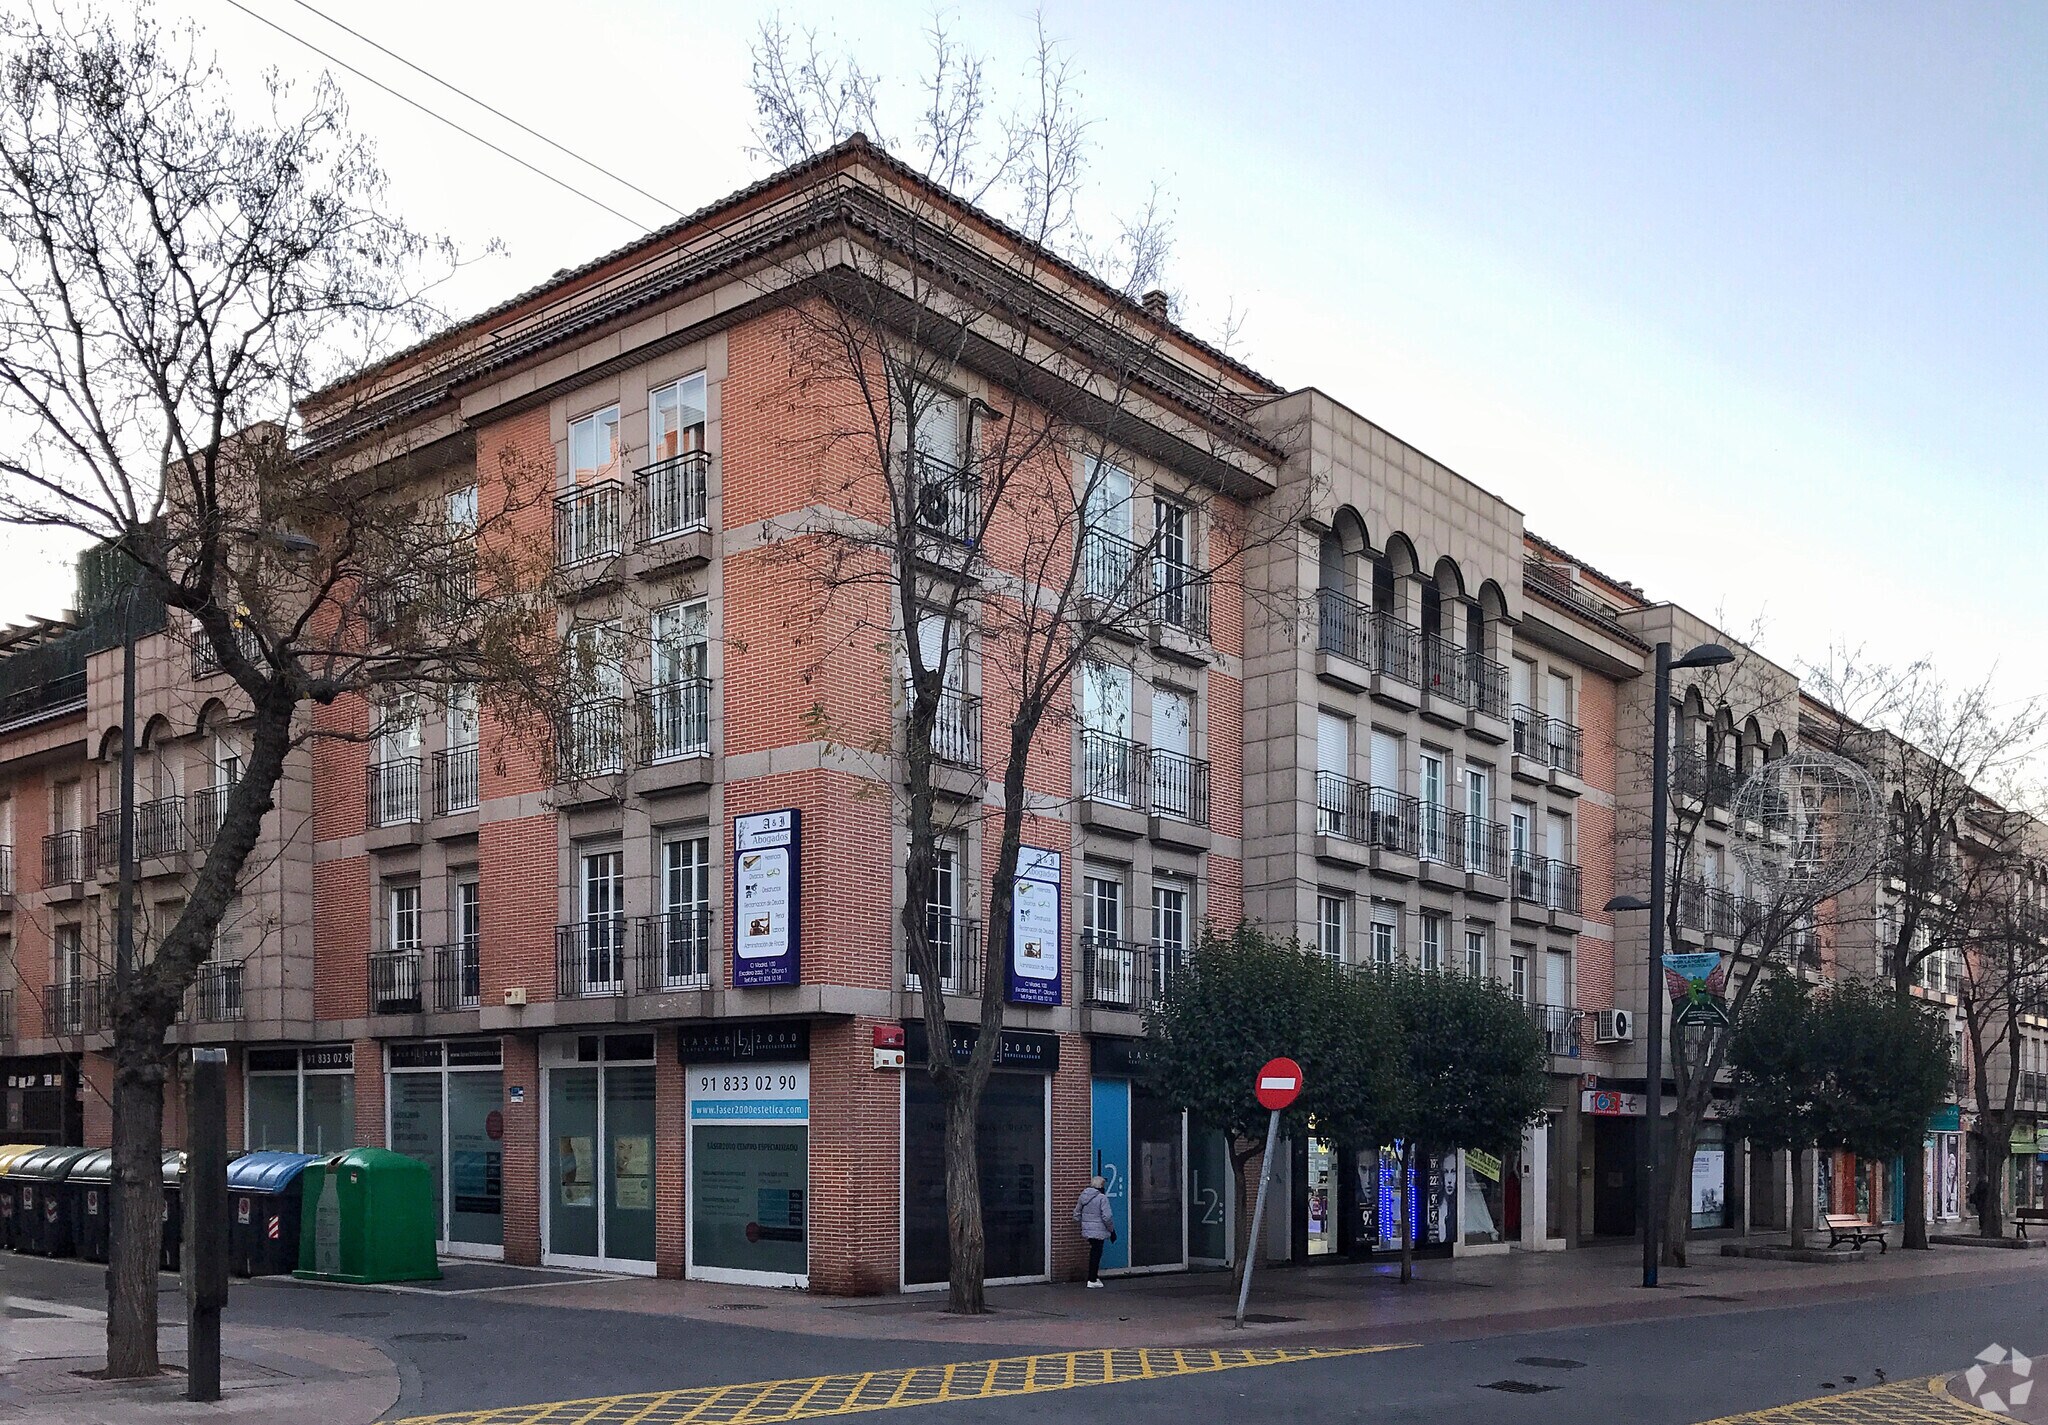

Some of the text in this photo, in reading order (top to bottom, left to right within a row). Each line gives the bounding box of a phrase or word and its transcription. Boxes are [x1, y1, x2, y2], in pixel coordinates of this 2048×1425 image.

[763, 818, 770, 829] A
[753, 832, 789, 845] Abogados
[756, 1032, 797, 1043] 2000
[1004, 1042, 1041, 1054] 2000
[306, 1052, 353, 1064] 91 833 02 90
[701, 1074, 797, 1092] 91 833 02 90
